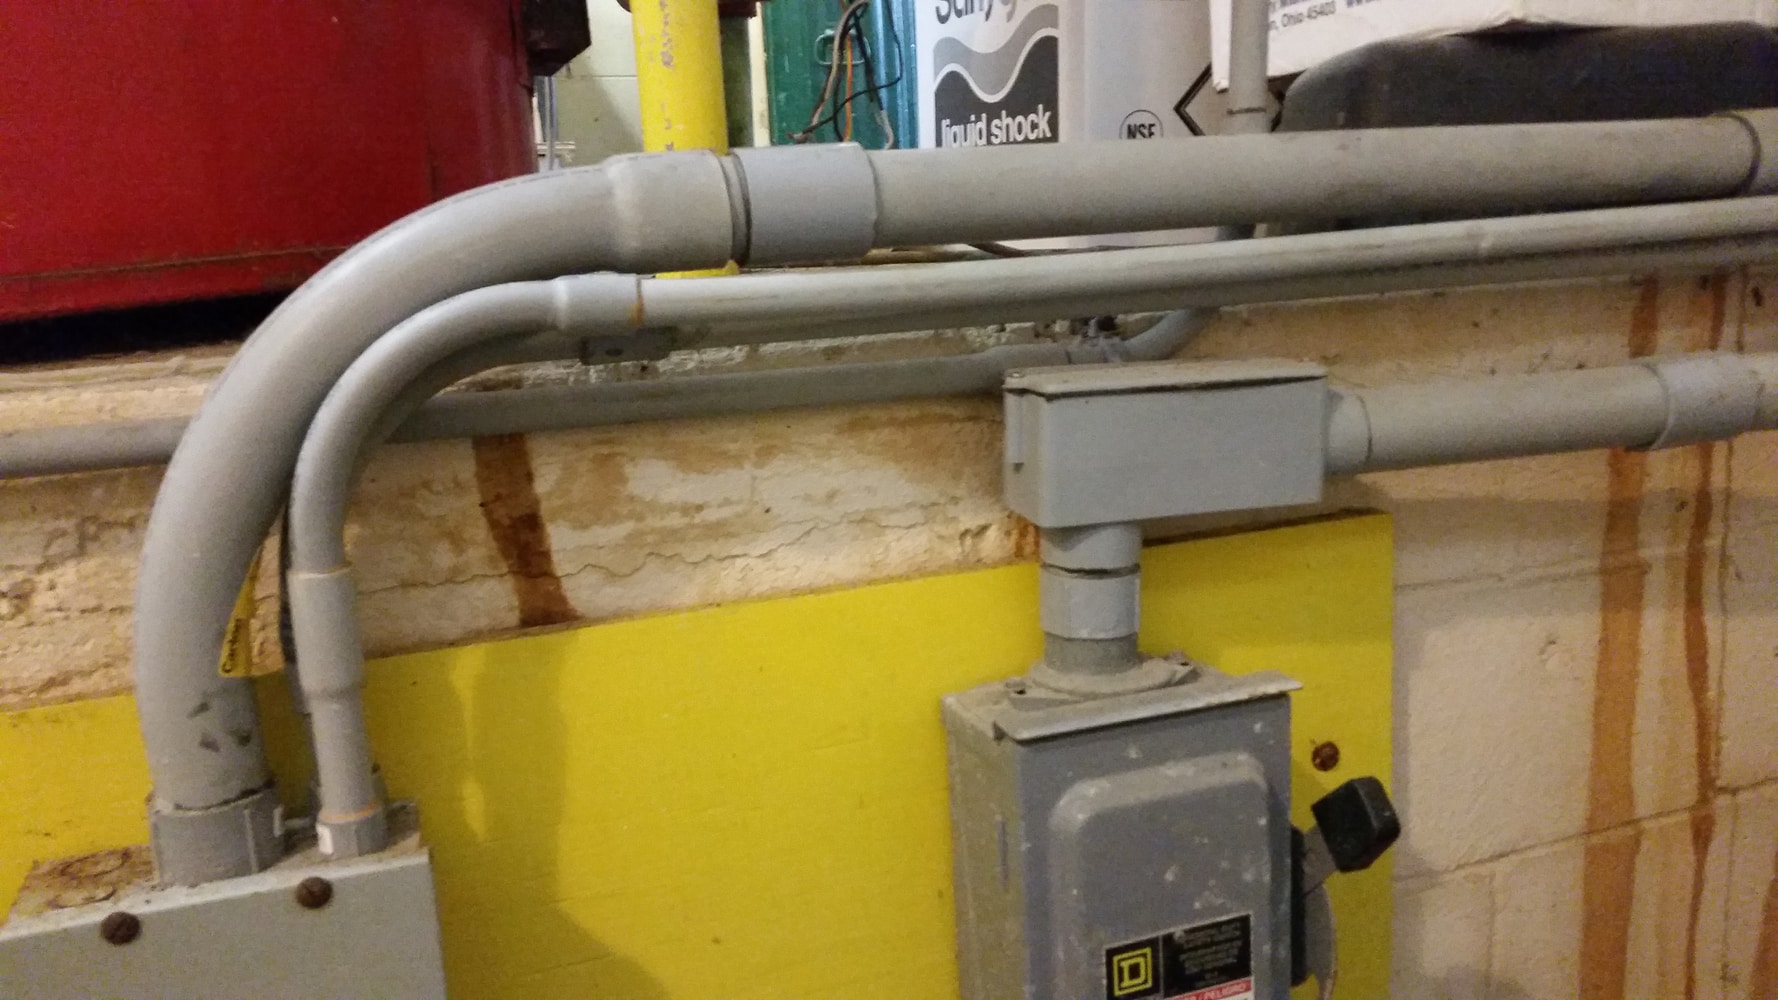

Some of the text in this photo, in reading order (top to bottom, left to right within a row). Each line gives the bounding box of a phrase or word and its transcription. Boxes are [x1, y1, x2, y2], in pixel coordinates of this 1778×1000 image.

[1281, 12, 1304, 27] Ohio
[941, 103, 1052, 148] liquid shock
[1127, 122, 1157, 140] NSF
